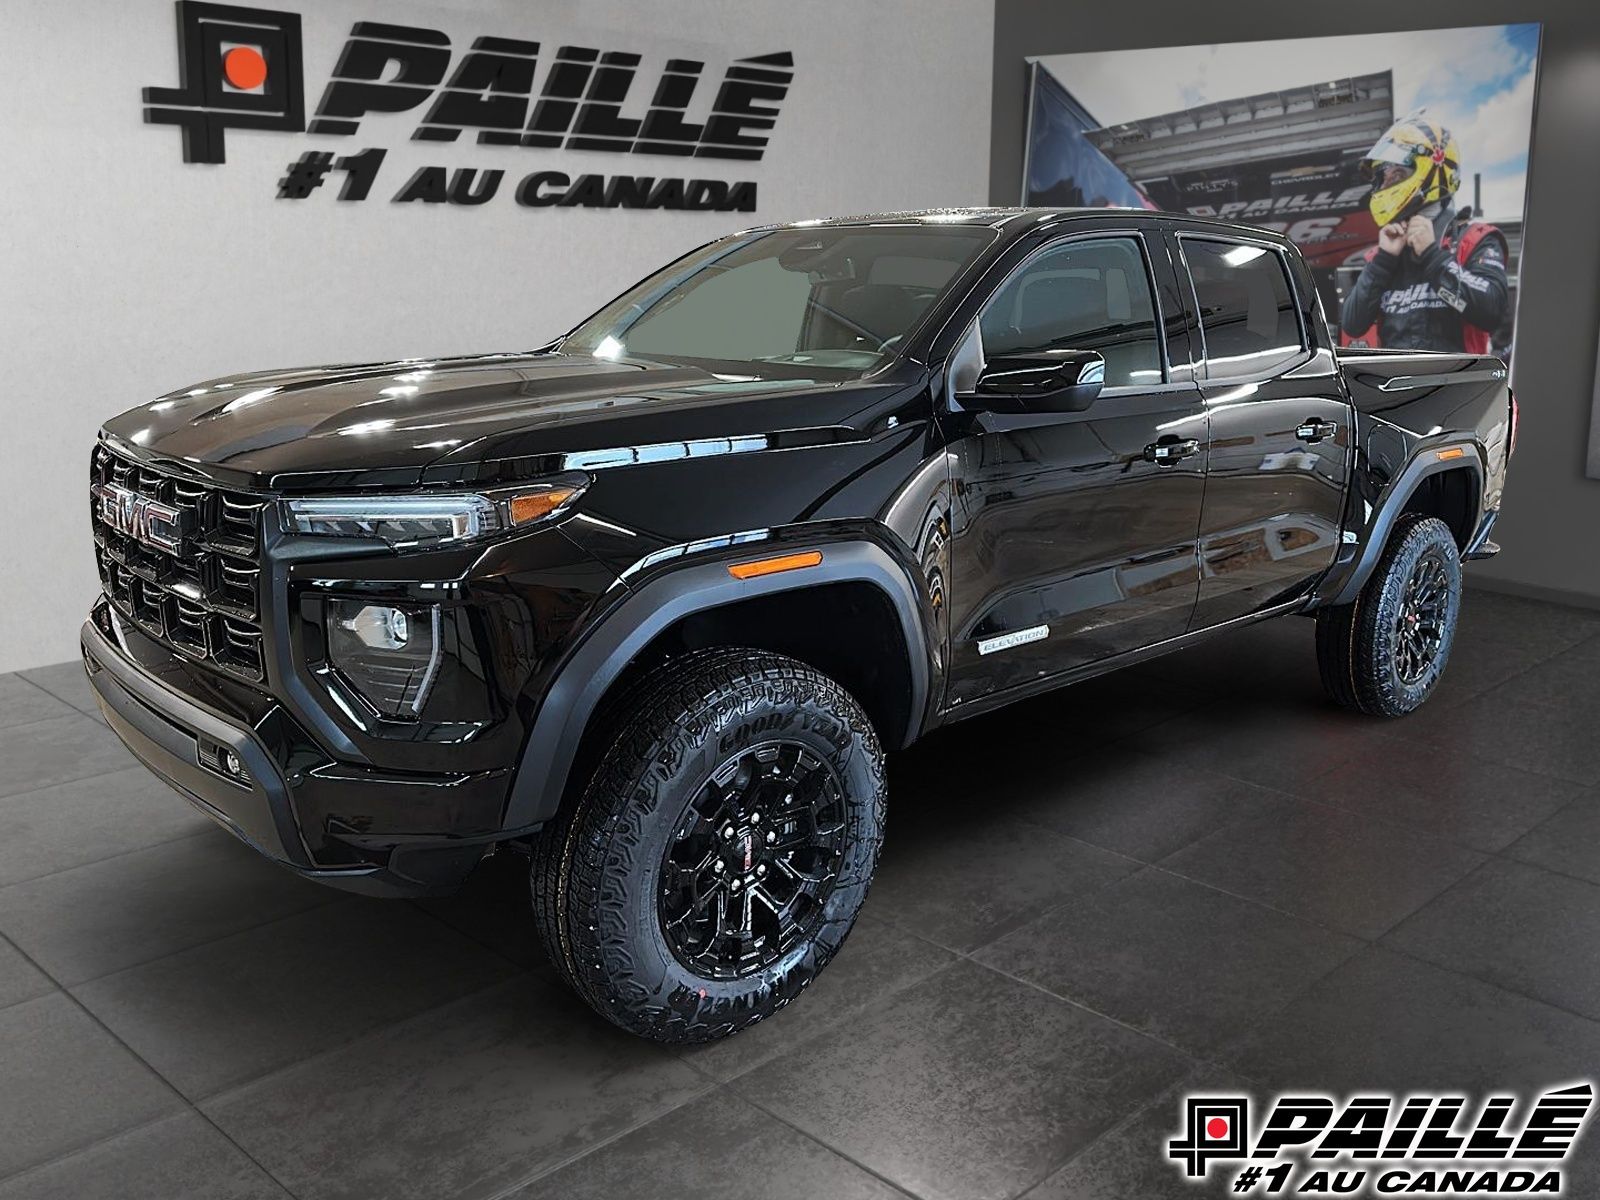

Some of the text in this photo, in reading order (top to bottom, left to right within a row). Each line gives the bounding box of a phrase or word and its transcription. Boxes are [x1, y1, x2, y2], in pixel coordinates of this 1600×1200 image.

[306, 21, 794, 161] PAILLÉ
[275, 147, 758, 213] #1 AU CANADA
[100, 482, 181, 557] GMC
[982, 628, 1046, 652] ELEVATION
